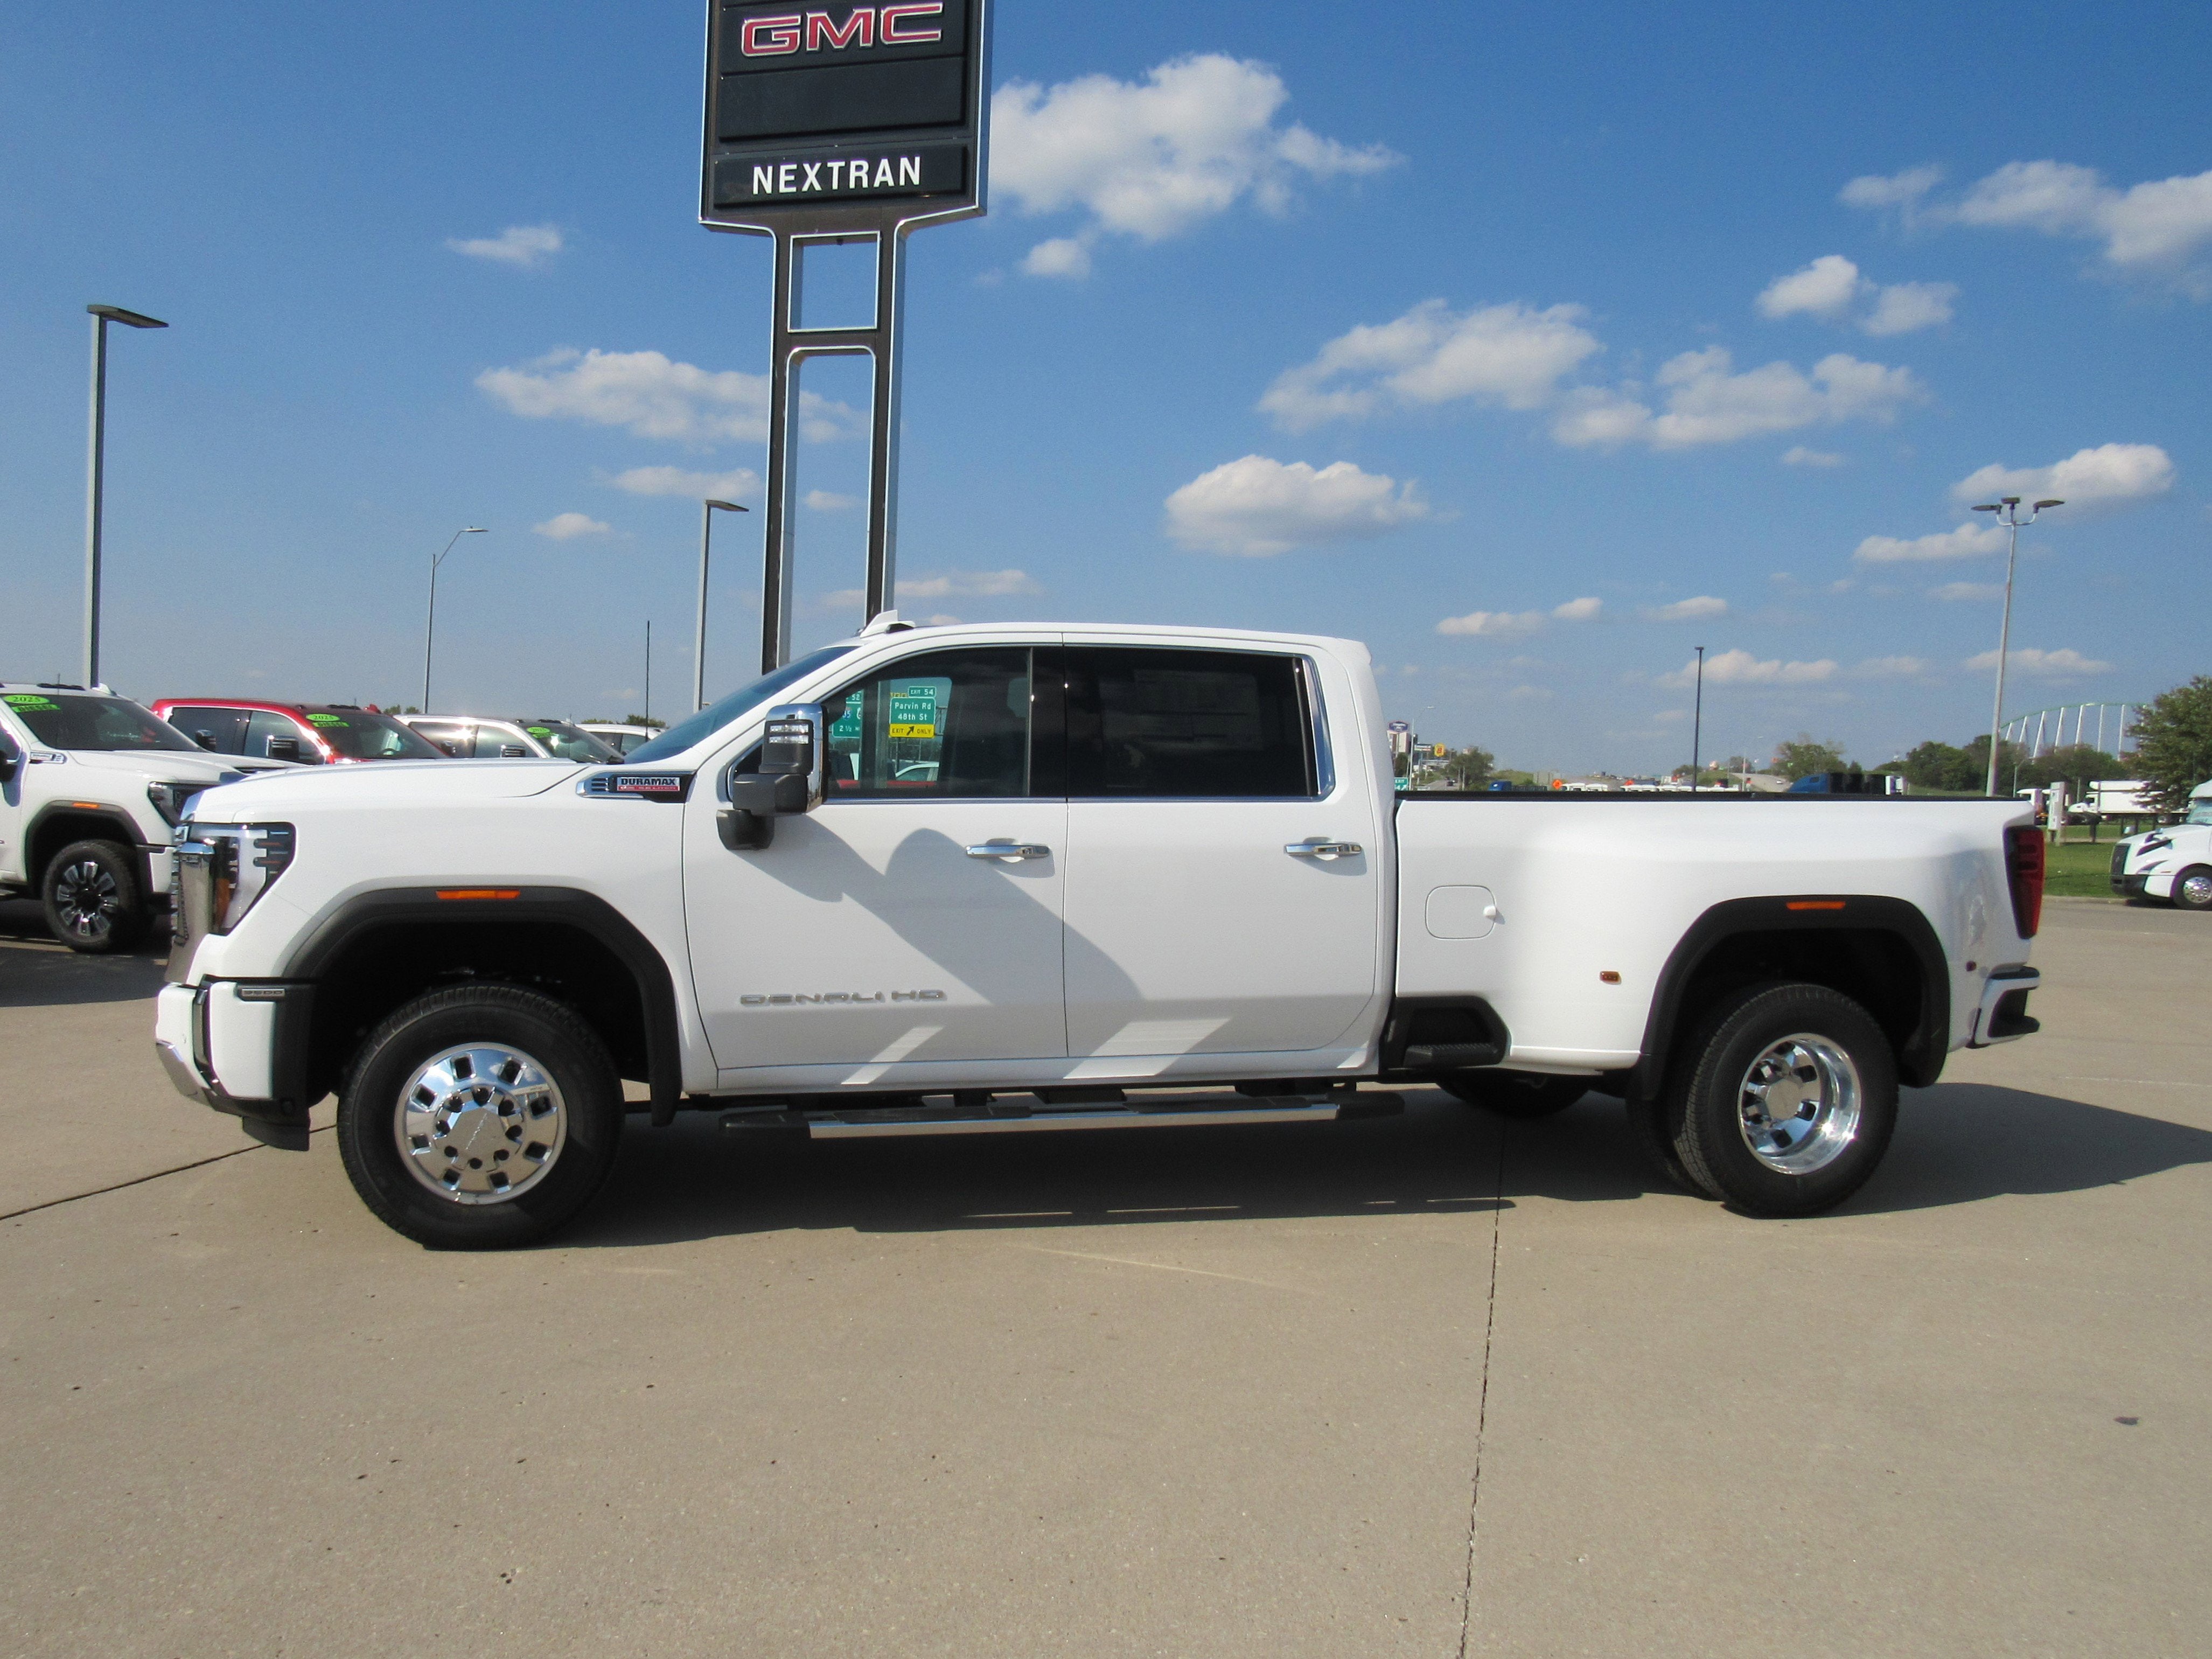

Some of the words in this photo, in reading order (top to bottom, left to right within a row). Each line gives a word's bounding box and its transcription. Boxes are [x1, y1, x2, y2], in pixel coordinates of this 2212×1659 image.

[741, 2, 943, 57] GMC
[752, 156, 920, 195] NEXTRAN
[740, 991, 884, 1005] DENALI
[891, 989, 945, 1001] HD
